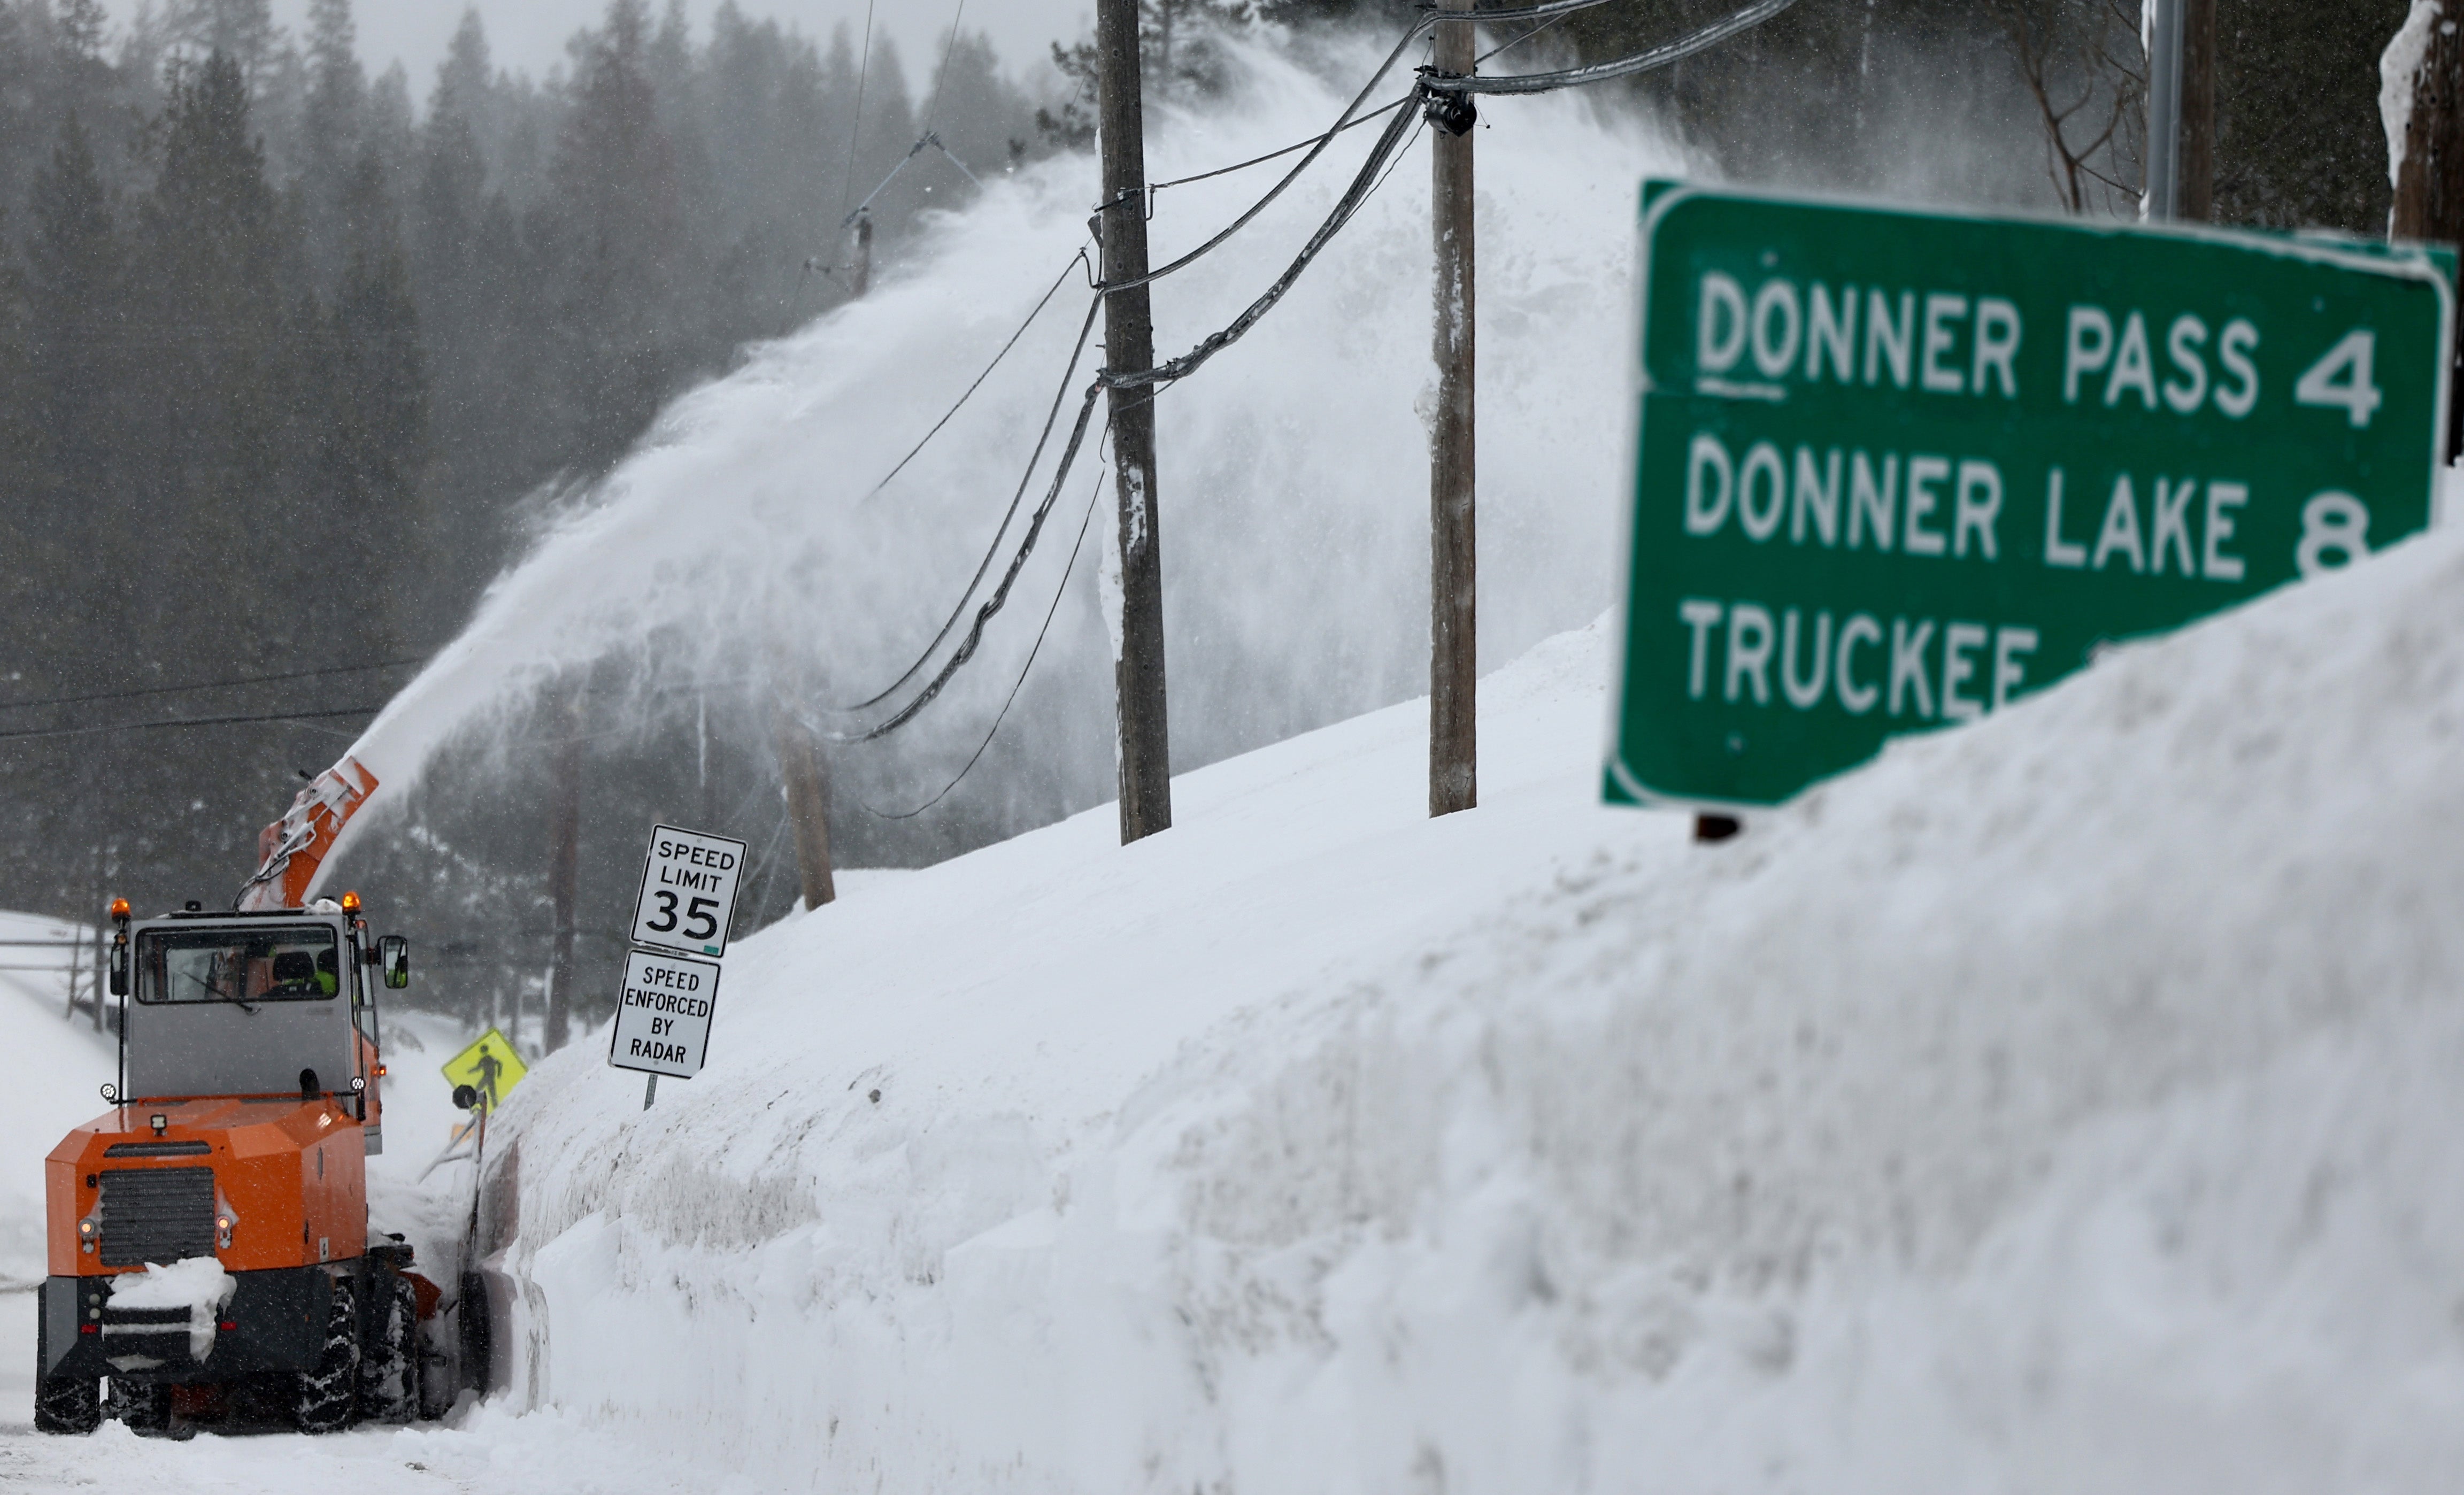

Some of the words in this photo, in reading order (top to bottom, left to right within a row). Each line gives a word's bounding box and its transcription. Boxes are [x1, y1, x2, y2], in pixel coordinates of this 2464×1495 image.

[1698, 272, 2020, 395] DONNER
[2066, 307, 2258, 416] PASS
[2296, 332, 2381, 425] 4
[1686, 435, 2002, 557] DONNER
[2045, 471, 2248, 580] LAKE
[2296, 490, 2369, 579] 8
[658, 841, 734, 870] SPEED
[661, 866, 722, 892] LIMIT
[646, 890, 719, 940] 35
[643, 967, 699, 991] SPEED
[625, 988, 708, 1017] ENFORCED
[651, 1017, 674, 1036] BY
[630, 1038, 686, 1064] RADAR
